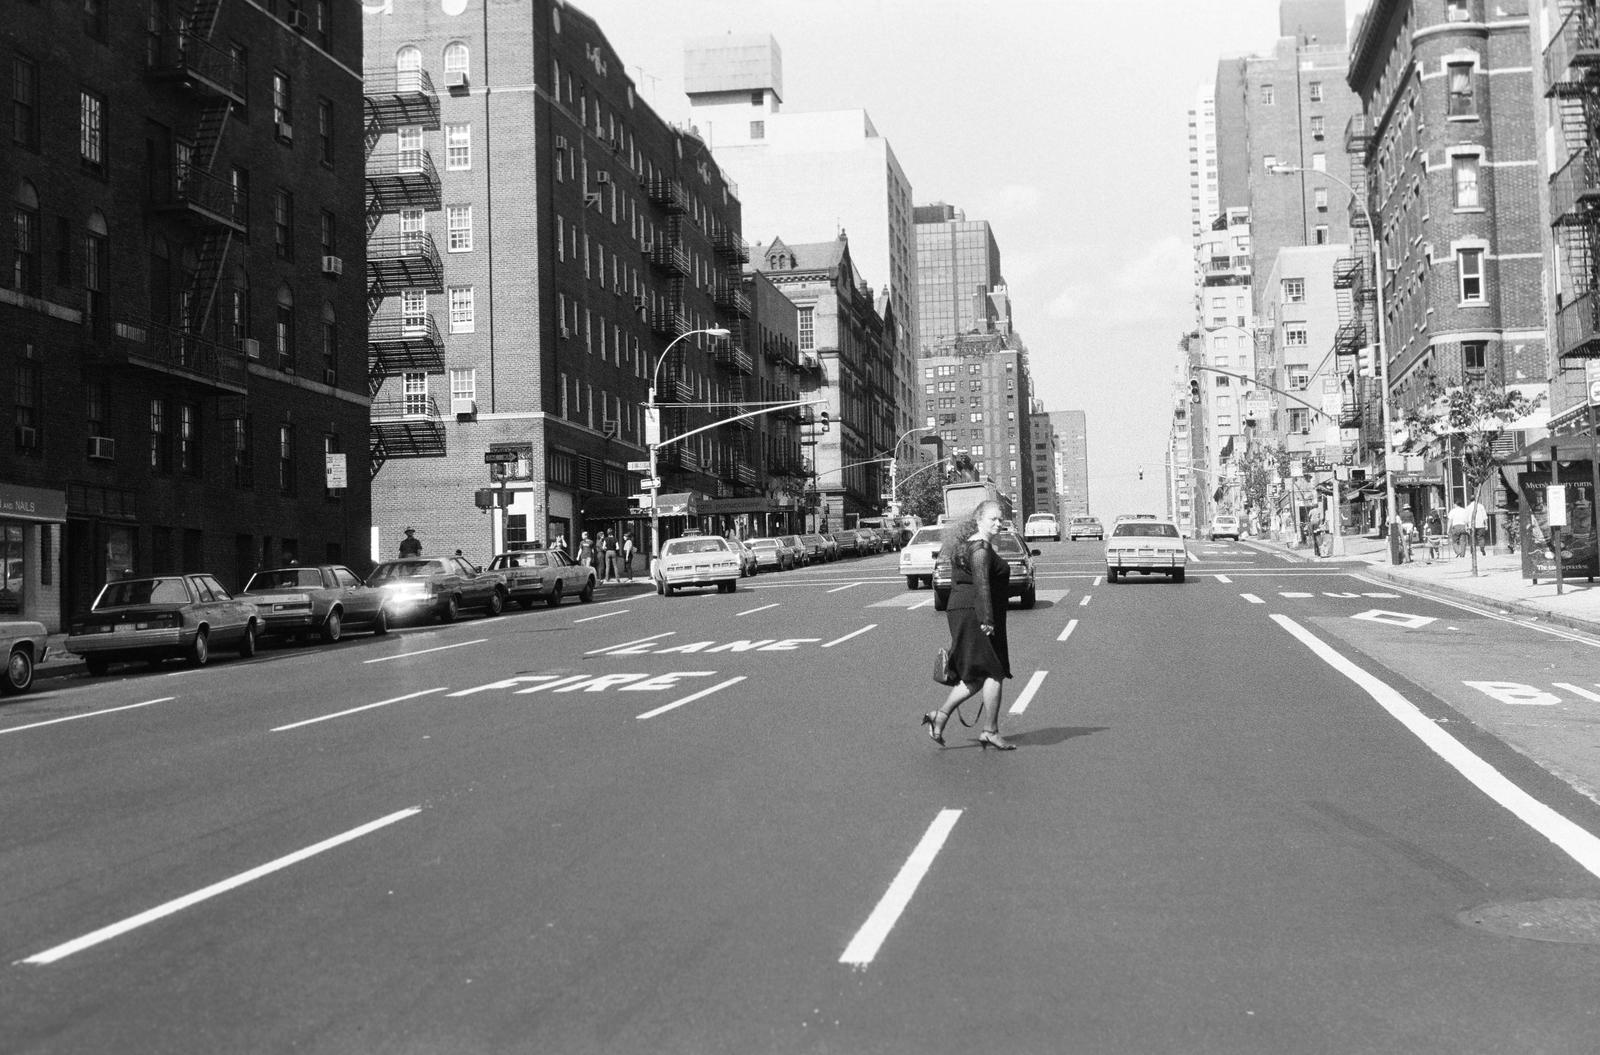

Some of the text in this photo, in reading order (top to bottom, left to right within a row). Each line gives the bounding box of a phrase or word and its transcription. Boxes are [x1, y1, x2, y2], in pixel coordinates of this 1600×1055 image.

[15, 500, 35, 512] NAILS
[606, 638, 822, 655] LANE
[445, 671, 718, 697] FIRE
